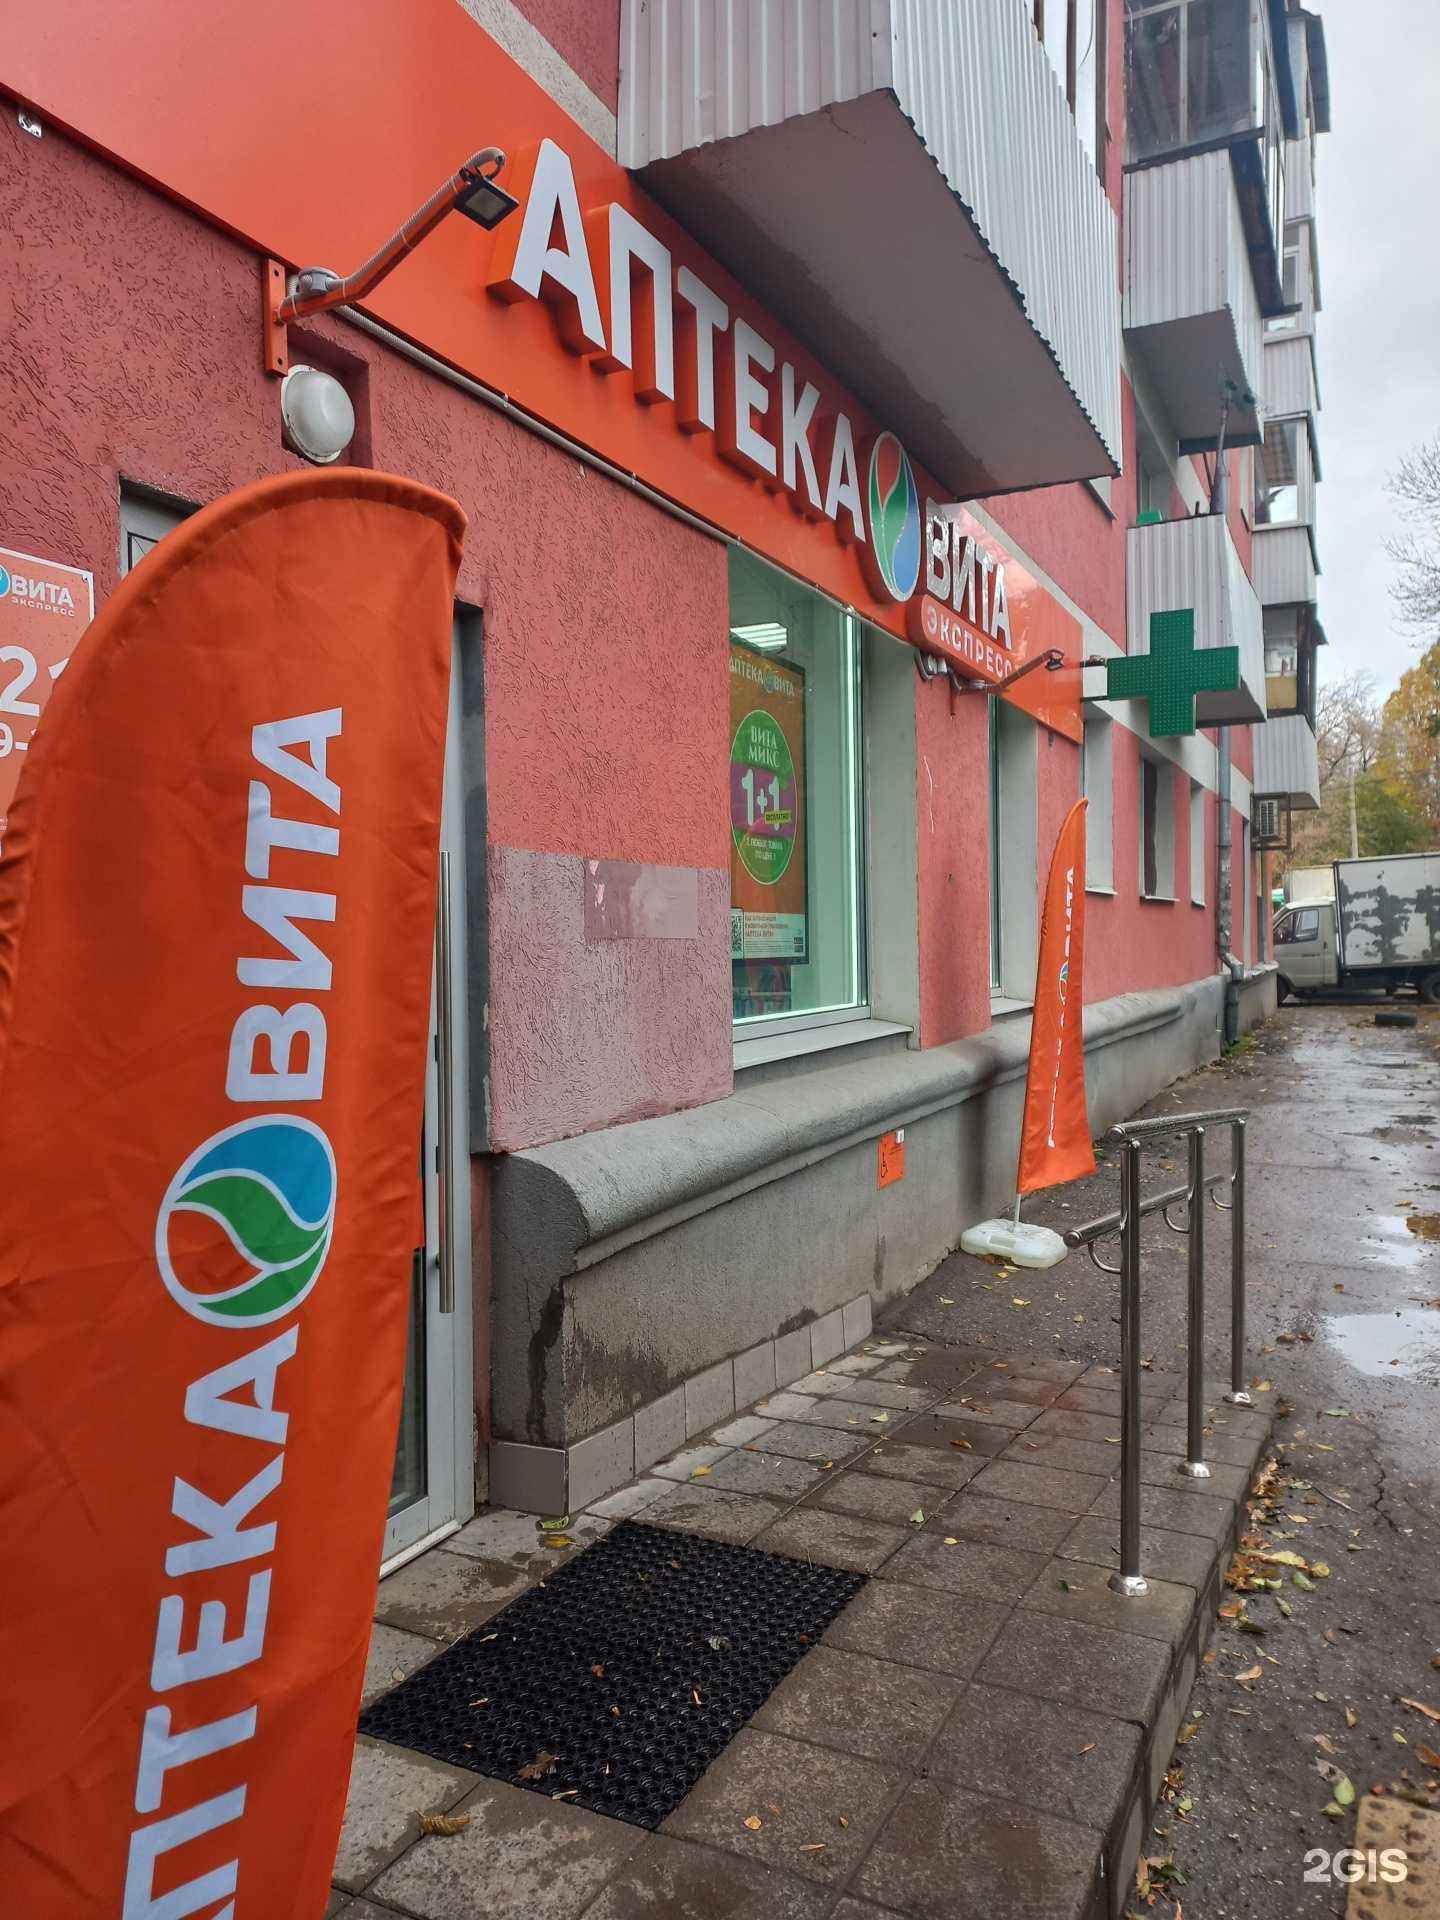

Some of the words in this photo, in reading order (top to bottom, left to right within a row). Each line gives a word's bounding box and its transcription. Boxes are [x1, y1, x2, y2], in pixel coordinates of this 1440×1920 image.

[511, 138, 867, 543] АПТЕКА
[926, 497, 1013, 650] ВИТА
[11, 574, 74, 608] ВИТА
[774, 675, 795, 697] ВИТА
[750, 726, 778, 750] ВИТА
[748, 743, 780, 768] МИКС
[741, 768, 780, 832] 1+1
[122, 1322, 300, 1920] ПТЕКА
[225, 706, 342, 1102] ВИТА
